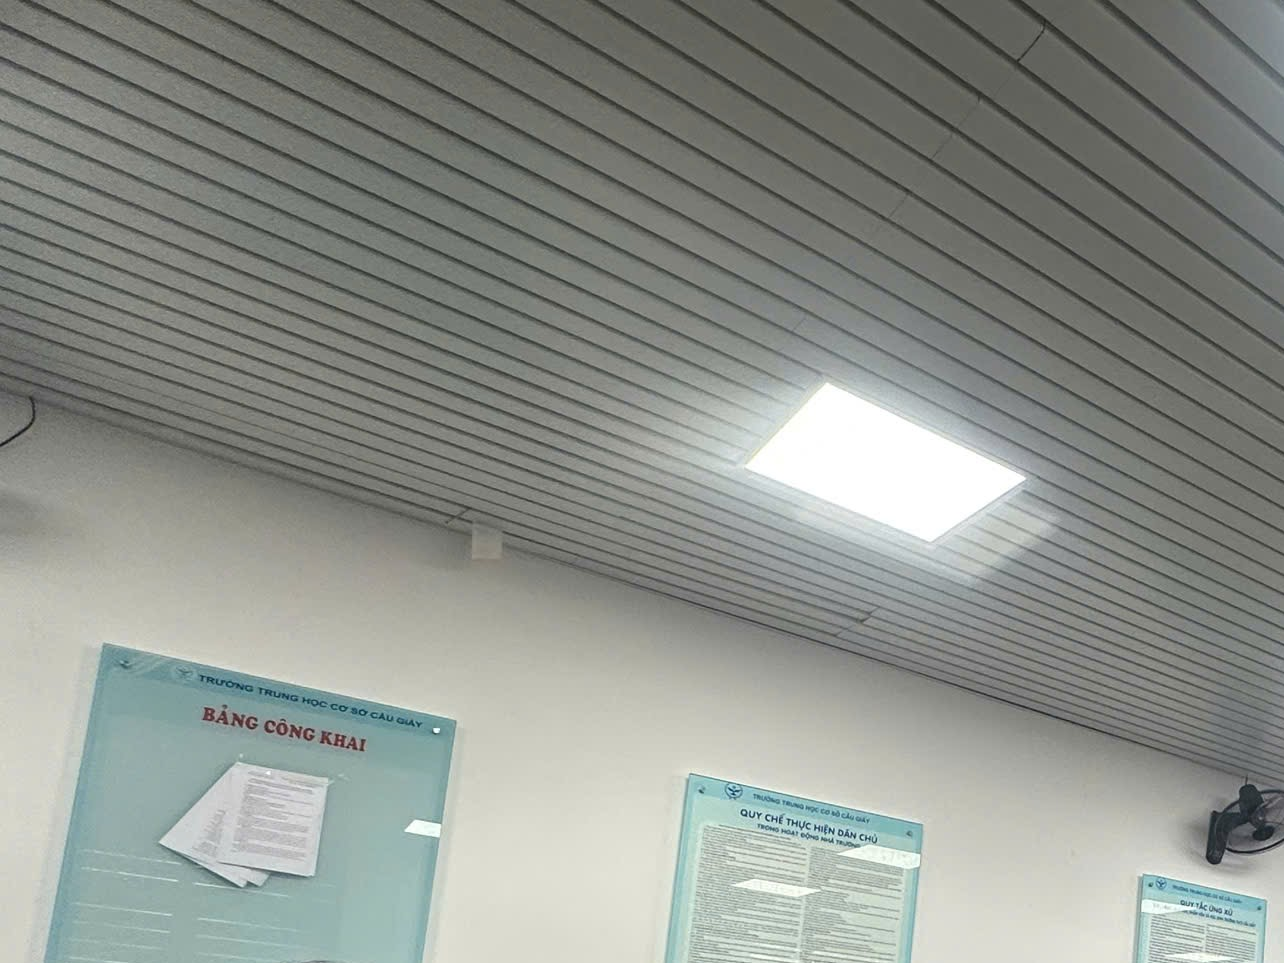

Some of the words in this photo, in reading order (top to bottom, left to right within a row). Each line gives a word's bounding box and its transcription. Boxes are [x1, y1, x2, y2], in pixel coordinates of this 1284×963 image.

[258, 686, 299, 702] TRUNG
[302, 696, 329, 710] HỌC
[202, 703, 259, 730] BẢNG
[264, 718, 316, 742] CÔNG
[319, 730, 367, 752] KHAI
[740, 808, 763, 820] QUY
[765, 812, 786, 825] CHẾ
[786, 817, 811, 831] THỰC
[814, 823, 835, 836] HIỆN
[838, 828, 856, 840] DÂN
[859, 832, 878, 844] CHỦ
[1180, 899, 1195, 907] QUY
